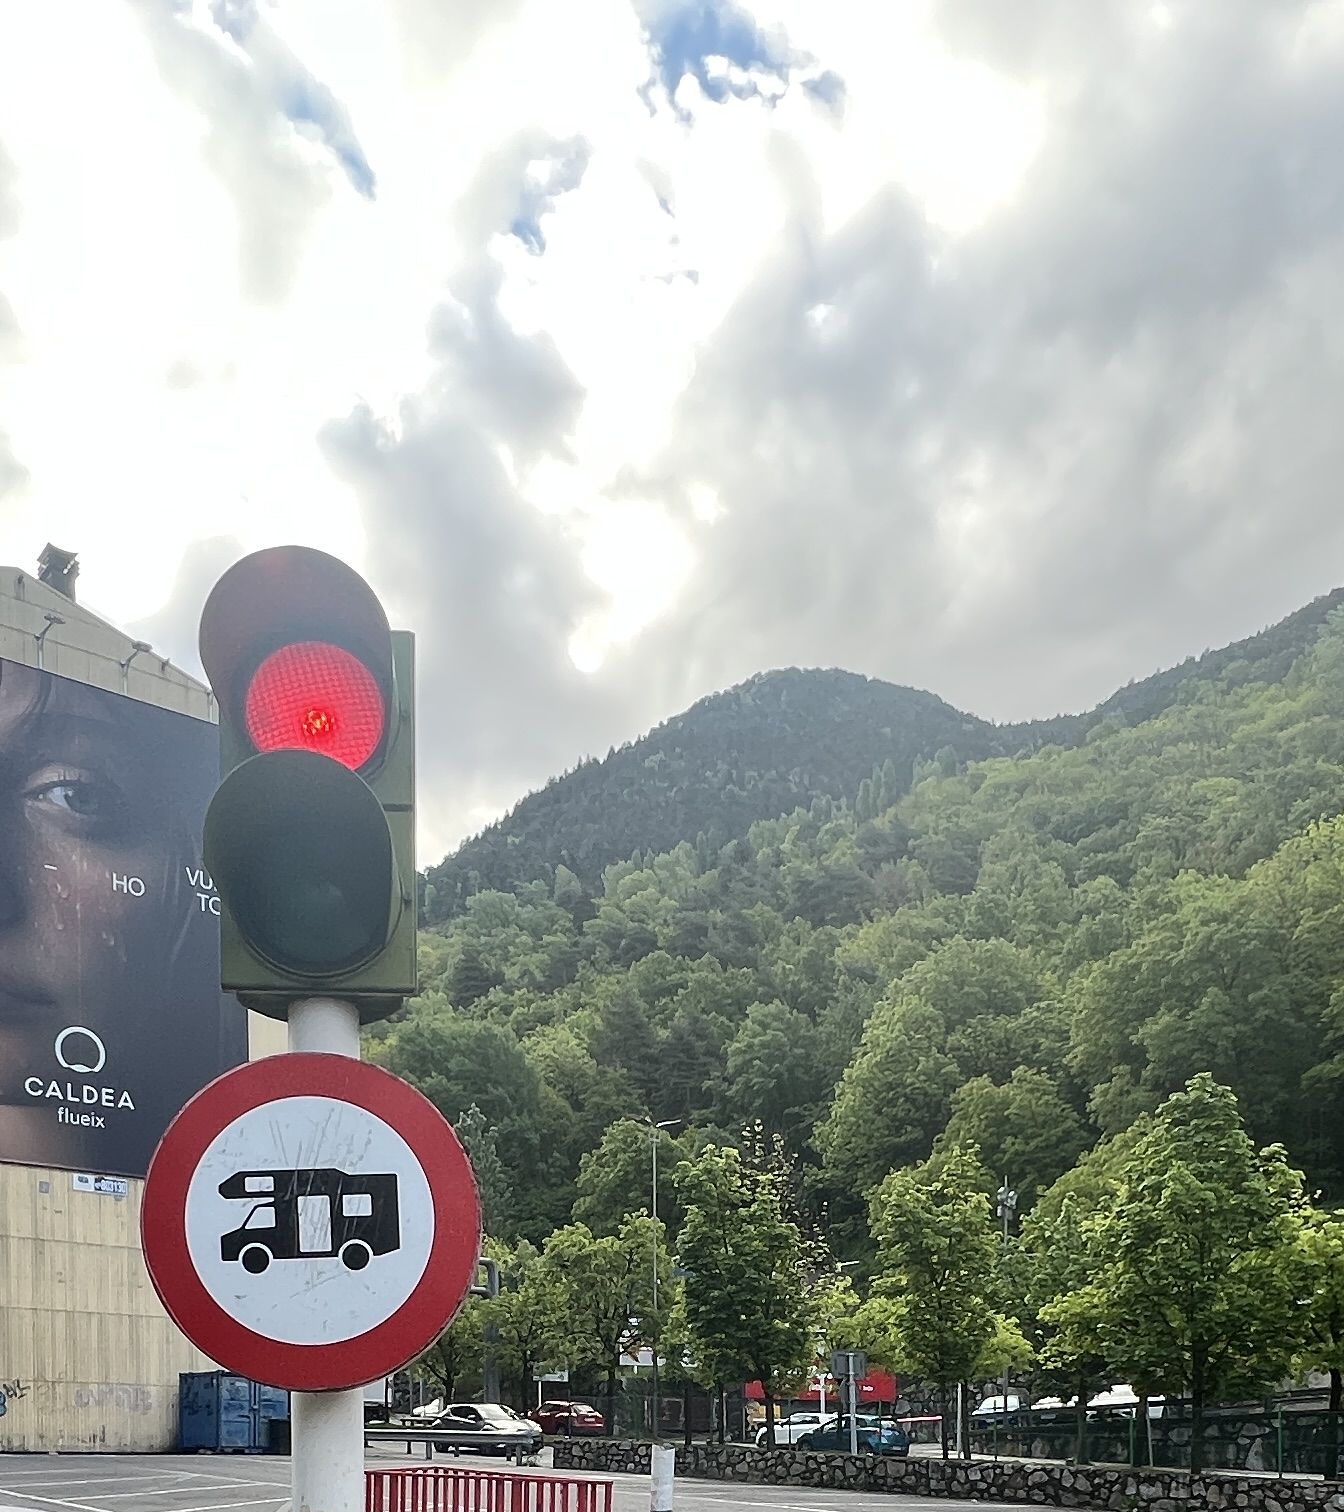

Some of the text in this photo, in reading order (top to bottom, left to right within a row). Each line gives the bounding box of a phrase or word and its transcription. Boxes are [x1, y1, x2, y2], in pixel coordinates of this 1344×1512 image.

[111, 871, 146, 898] HO
[24, 1076, 136, 1111] CALDEA
[57, 1107, 106, 1130] flueix
